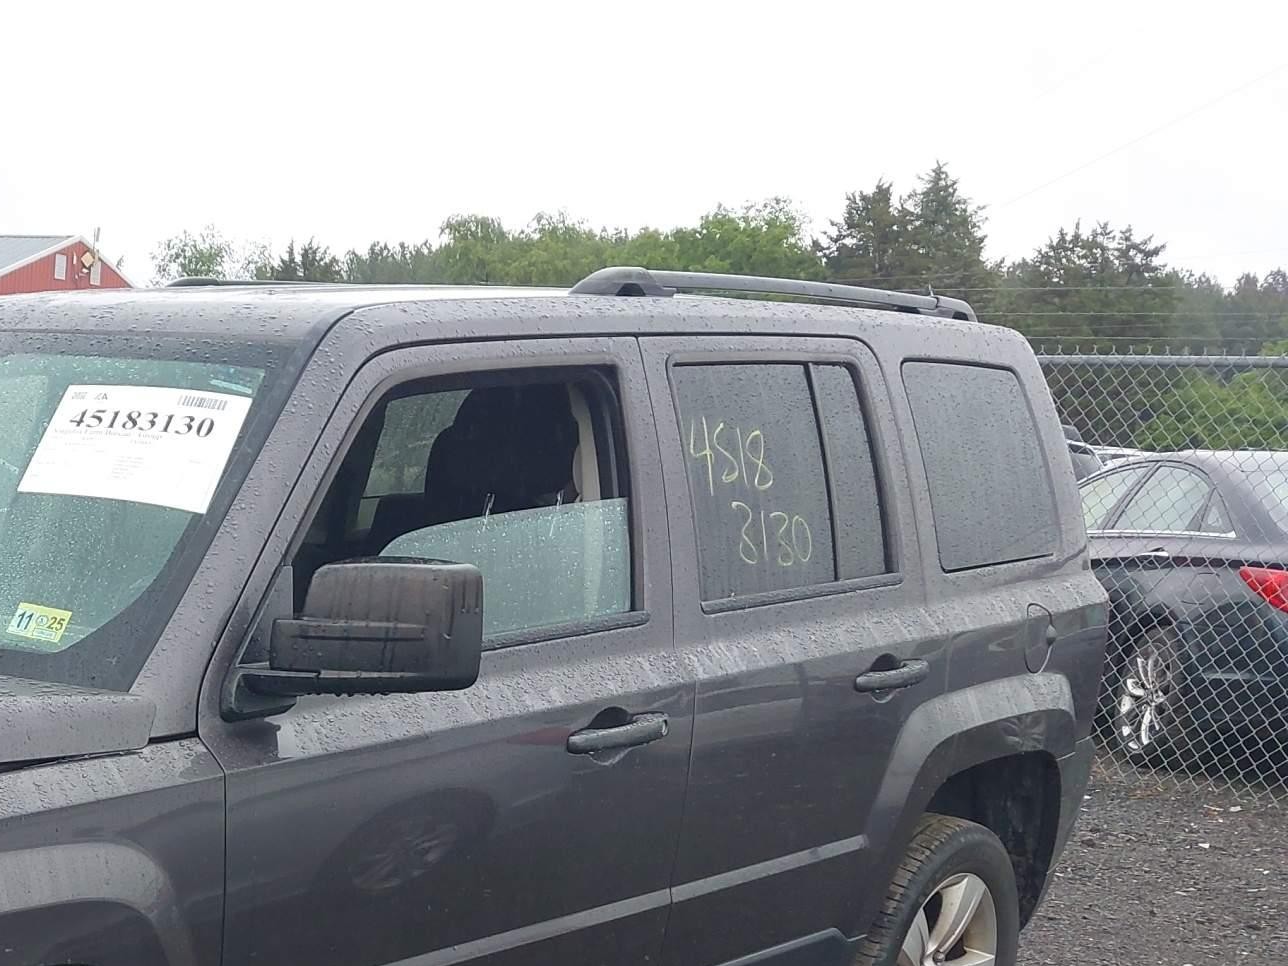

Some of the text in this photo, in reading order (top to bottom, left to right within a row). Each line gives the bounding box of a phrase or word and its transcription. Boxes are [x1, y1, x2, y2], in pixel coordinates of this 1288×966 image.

[68, 408, 215, 438] 45183130
[689, 415, 774, 496] 4518
[731, 501, 813, 566] 3130
[16, 610, 35, 631] 11
[46, 615, 66, 632] 25
